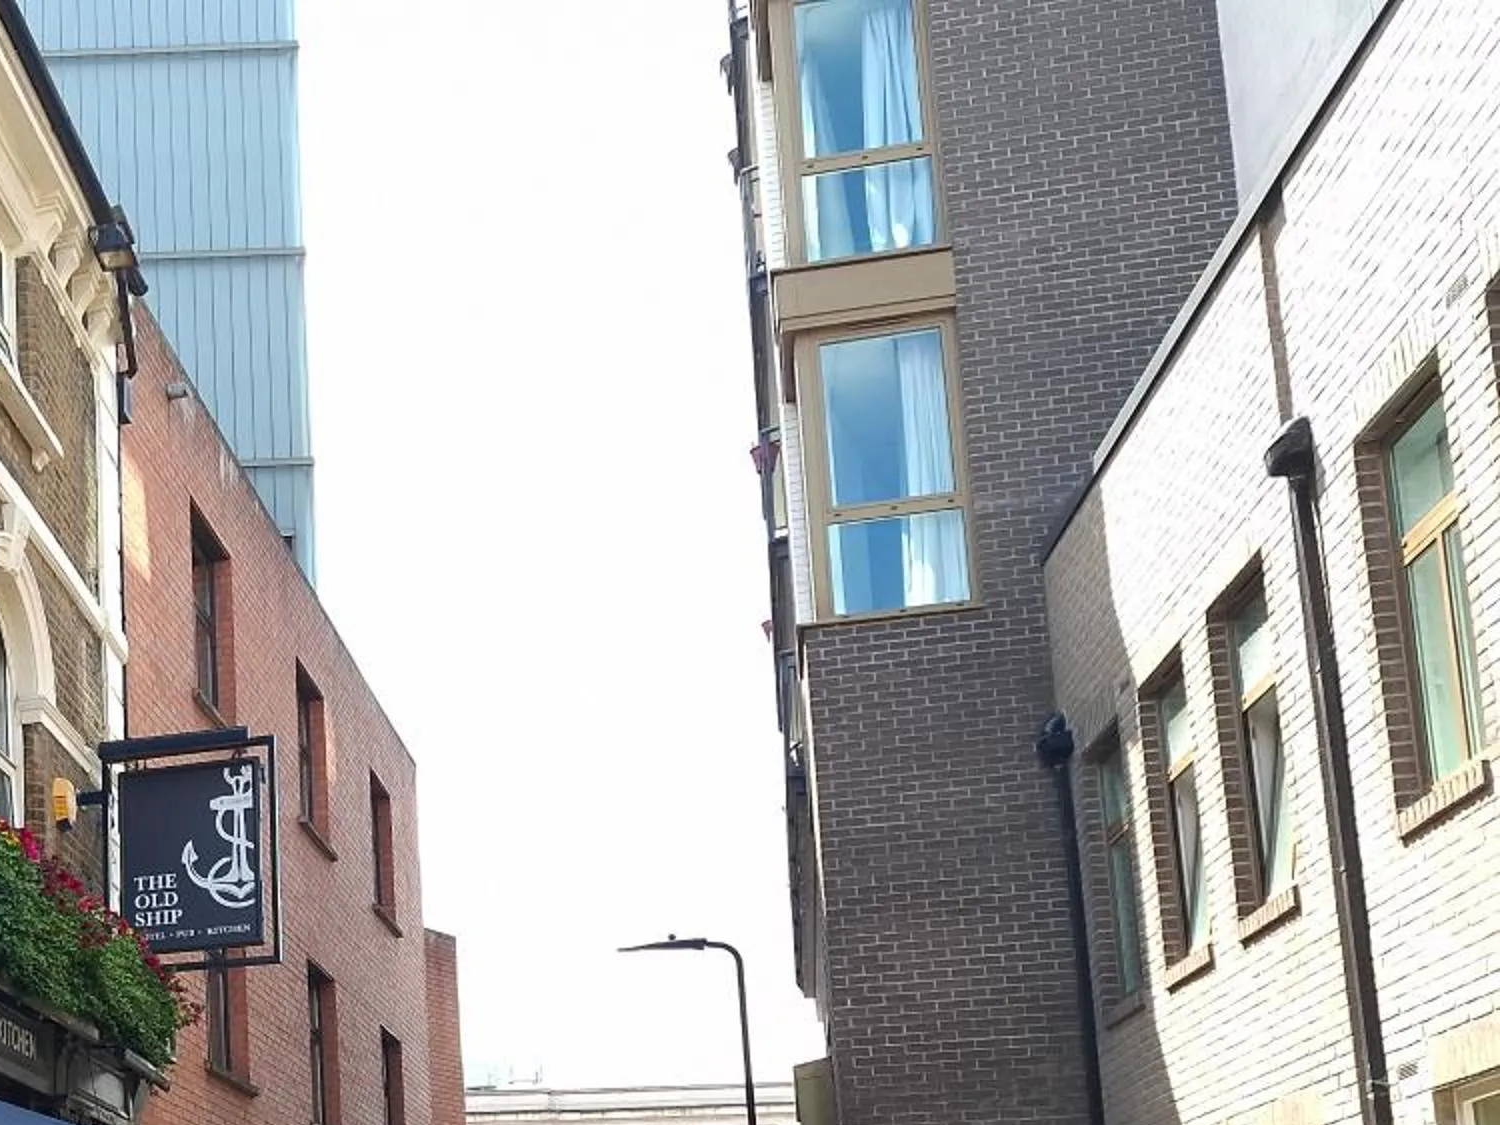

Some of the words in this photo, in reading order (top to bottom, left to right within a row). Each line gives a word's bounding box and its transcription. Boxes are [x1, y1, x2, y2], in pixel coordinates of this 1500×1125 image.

[134, 873, 177, 891] THE
[135, 891, 179, 910] OLD
[135, 909, 183, 928] SHIP
